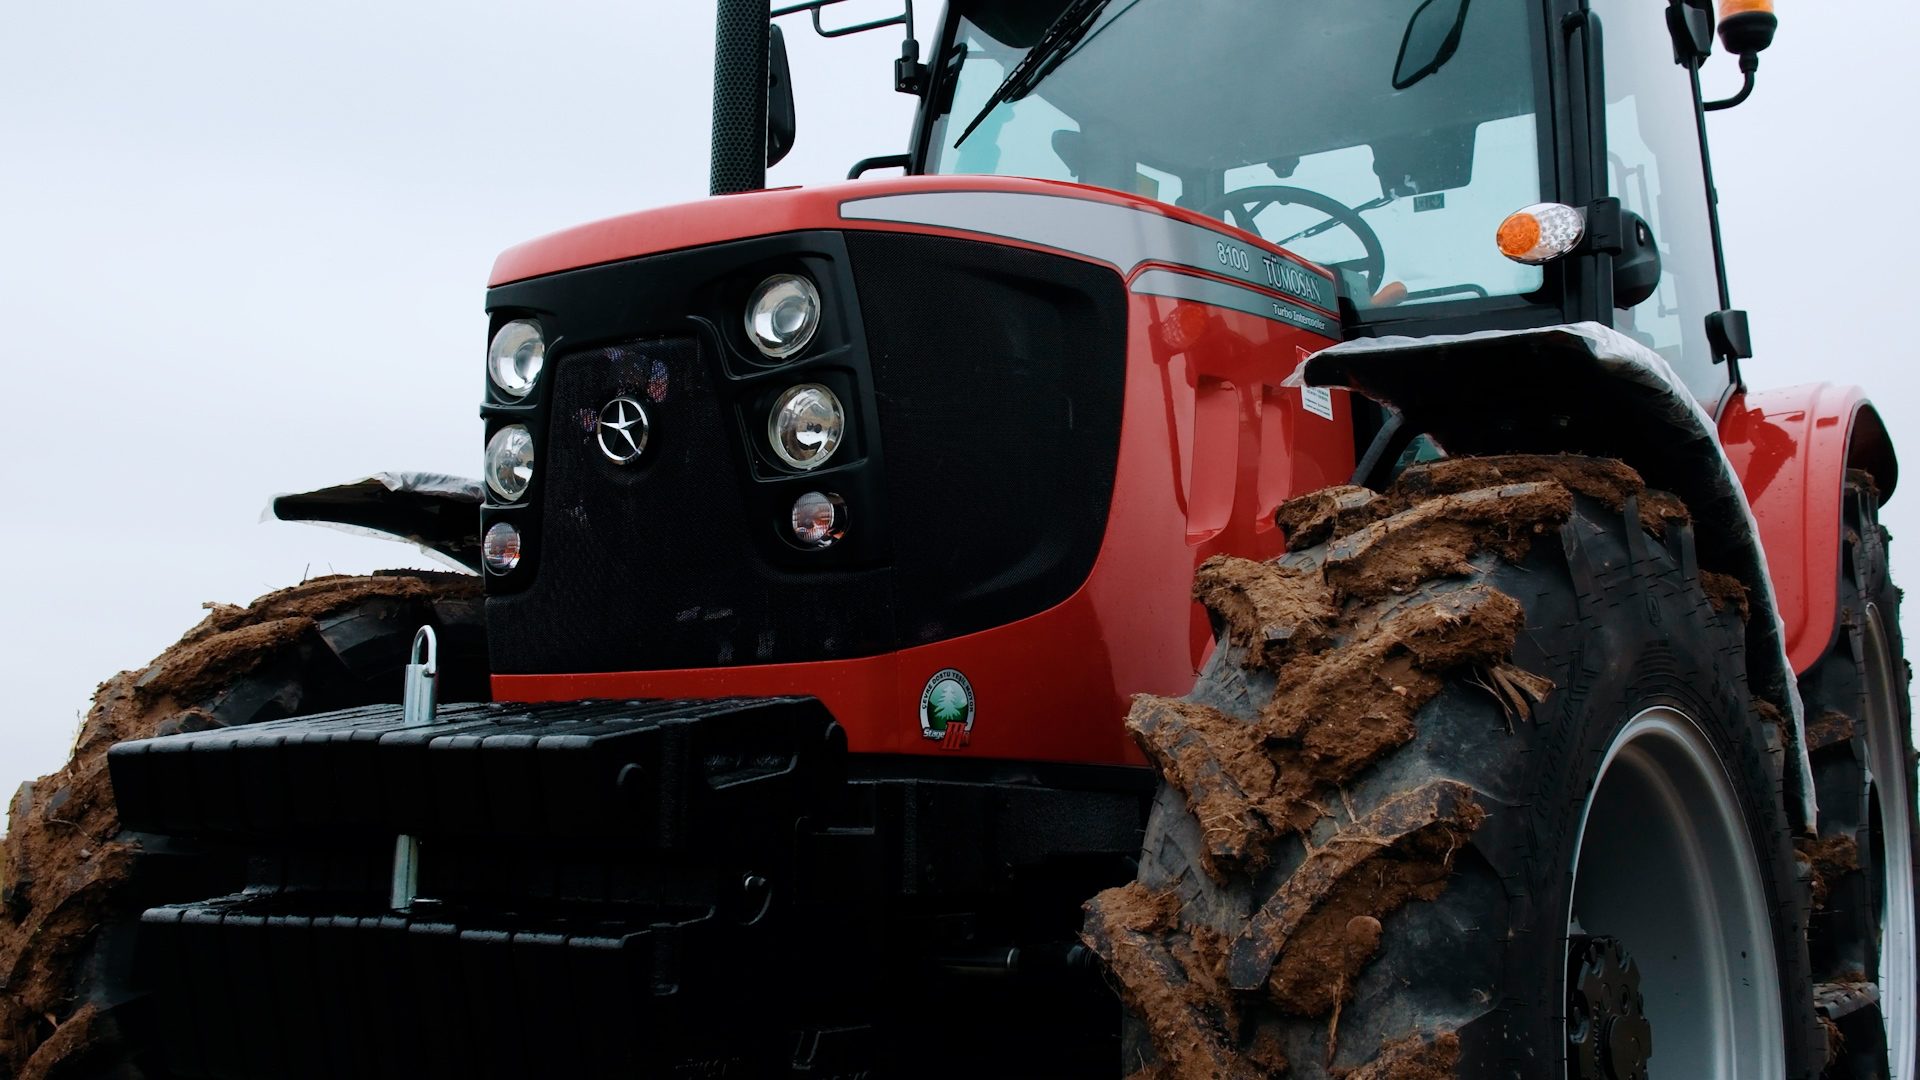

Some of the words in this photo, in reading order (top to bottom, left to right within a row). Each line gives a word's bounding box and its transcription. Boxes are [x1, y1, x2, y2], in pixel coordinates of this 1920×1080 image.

[1216, 242, 1249, 272] 8100
[1262, 256, 1322, 302] TÜMOSAN
[1272, 303, 1293, 320] Turbo
[1293, 310, 1326, 330] Intercooler
